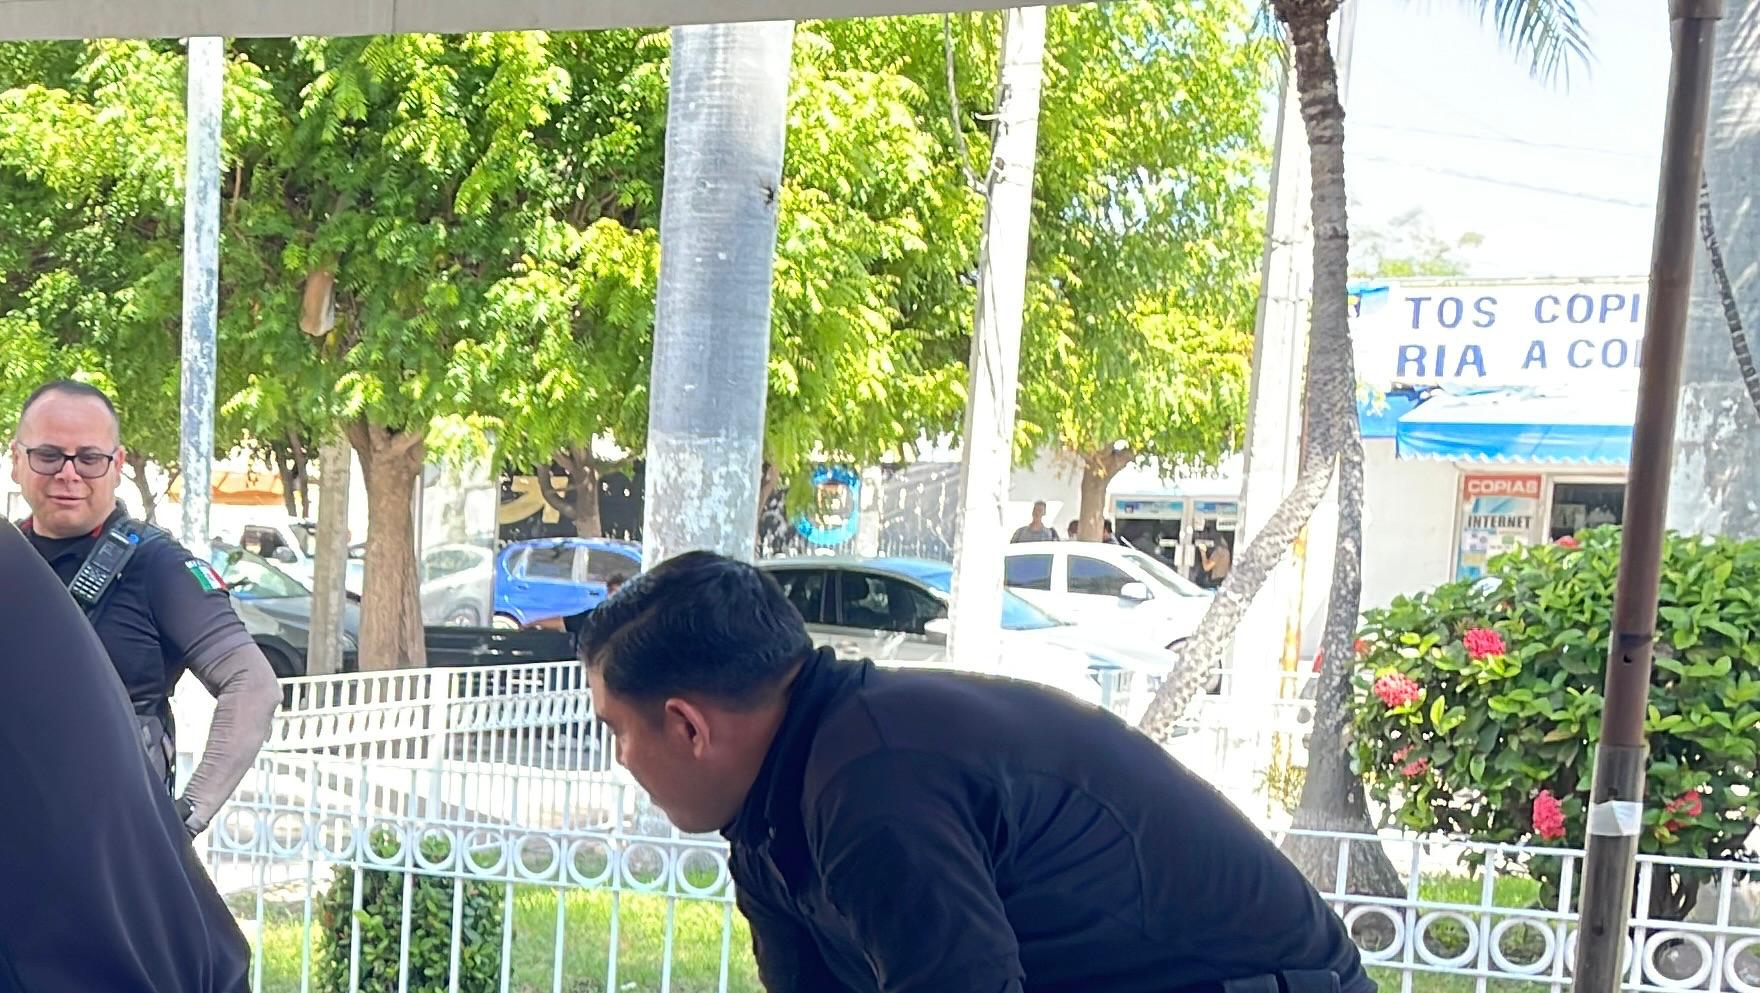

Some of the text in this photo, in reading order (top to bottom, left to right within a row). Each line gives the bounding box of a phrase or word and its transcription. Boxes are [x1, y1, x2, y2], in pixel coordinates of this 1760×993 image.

[1396, 344, 1487, 377] RIA
[1521, 340, 1548, 369] A
[1468, 480, 1537, 494] COPIAS
[1468, 515, 1532, 529] INTERNET
